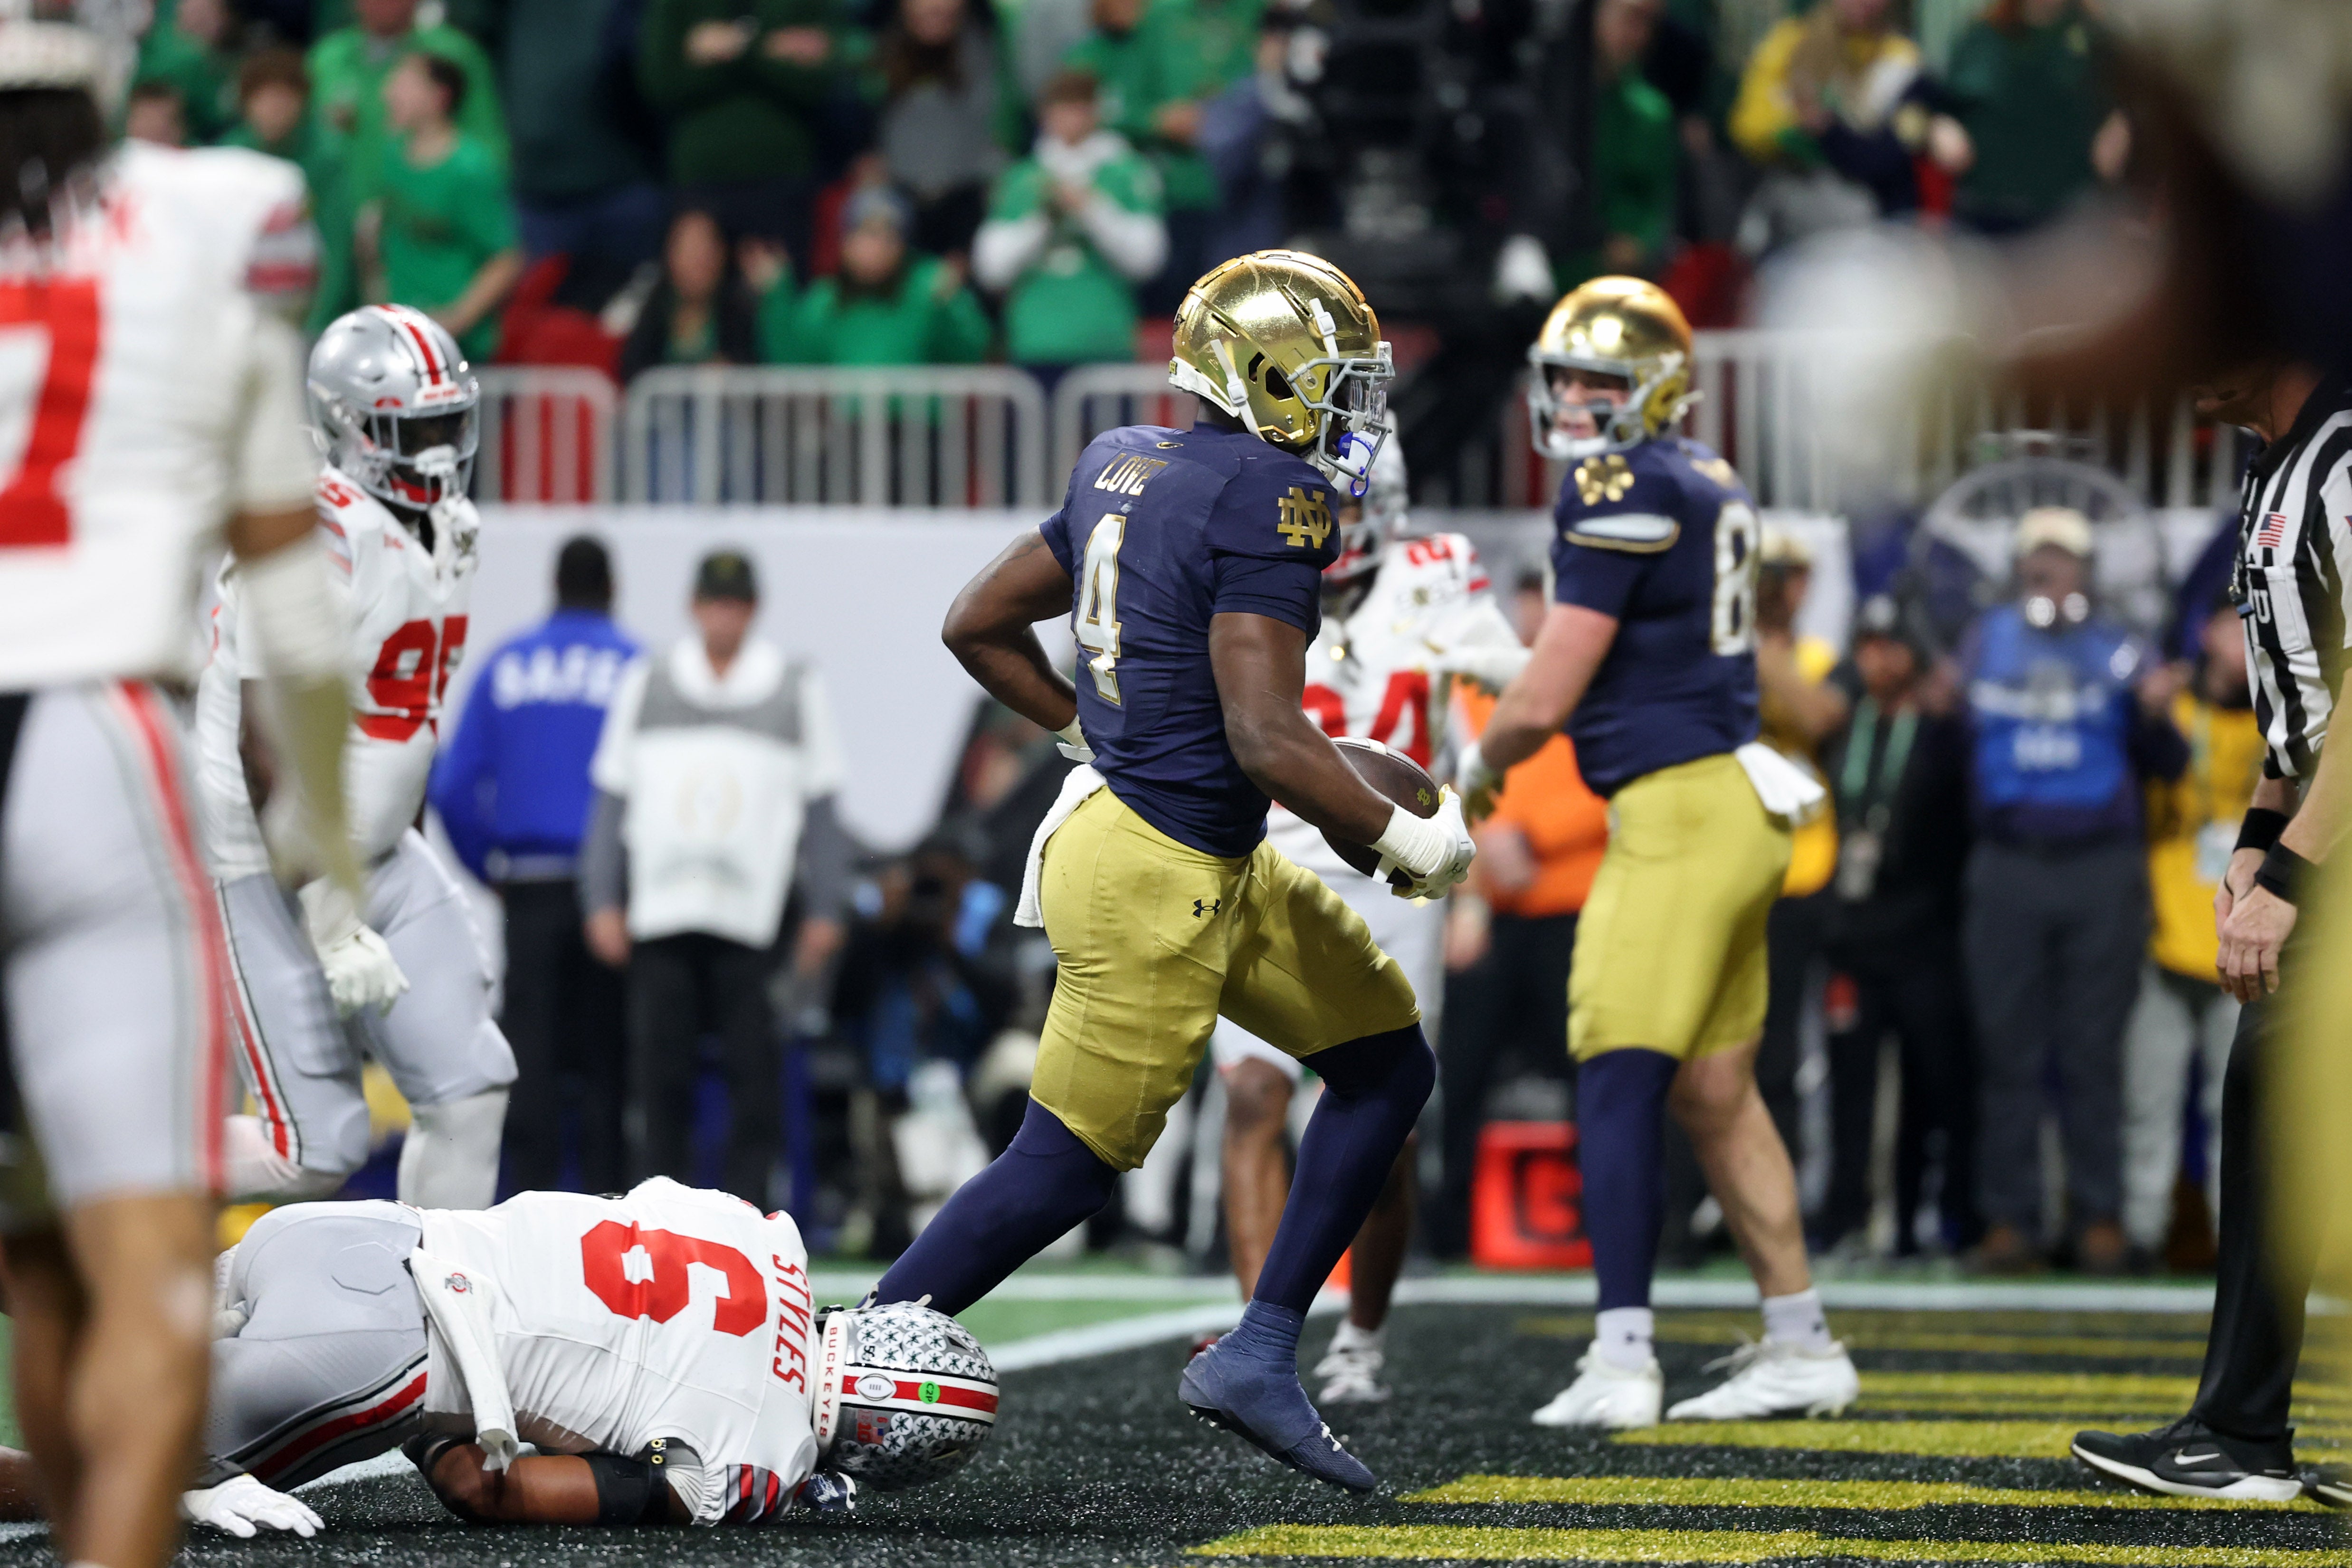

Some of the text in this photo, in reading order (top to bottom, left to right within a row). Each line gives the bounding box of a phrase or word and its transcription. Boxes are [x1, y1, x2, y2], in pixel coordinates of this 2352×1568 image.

[1094, 452, 1168, 496] LOVE
[1075, 513, 1127, 706] 4
[1711, 499, 1761, 656] 8
[2253, 589, 2271, 624] U
[581, 1220, 767, 1337] 6
[772, 1254, 813, 1395] STYLES
[819, 1327, 838, 1437] BUCKEYES
[924, 1382, 934, 1402] C2P
